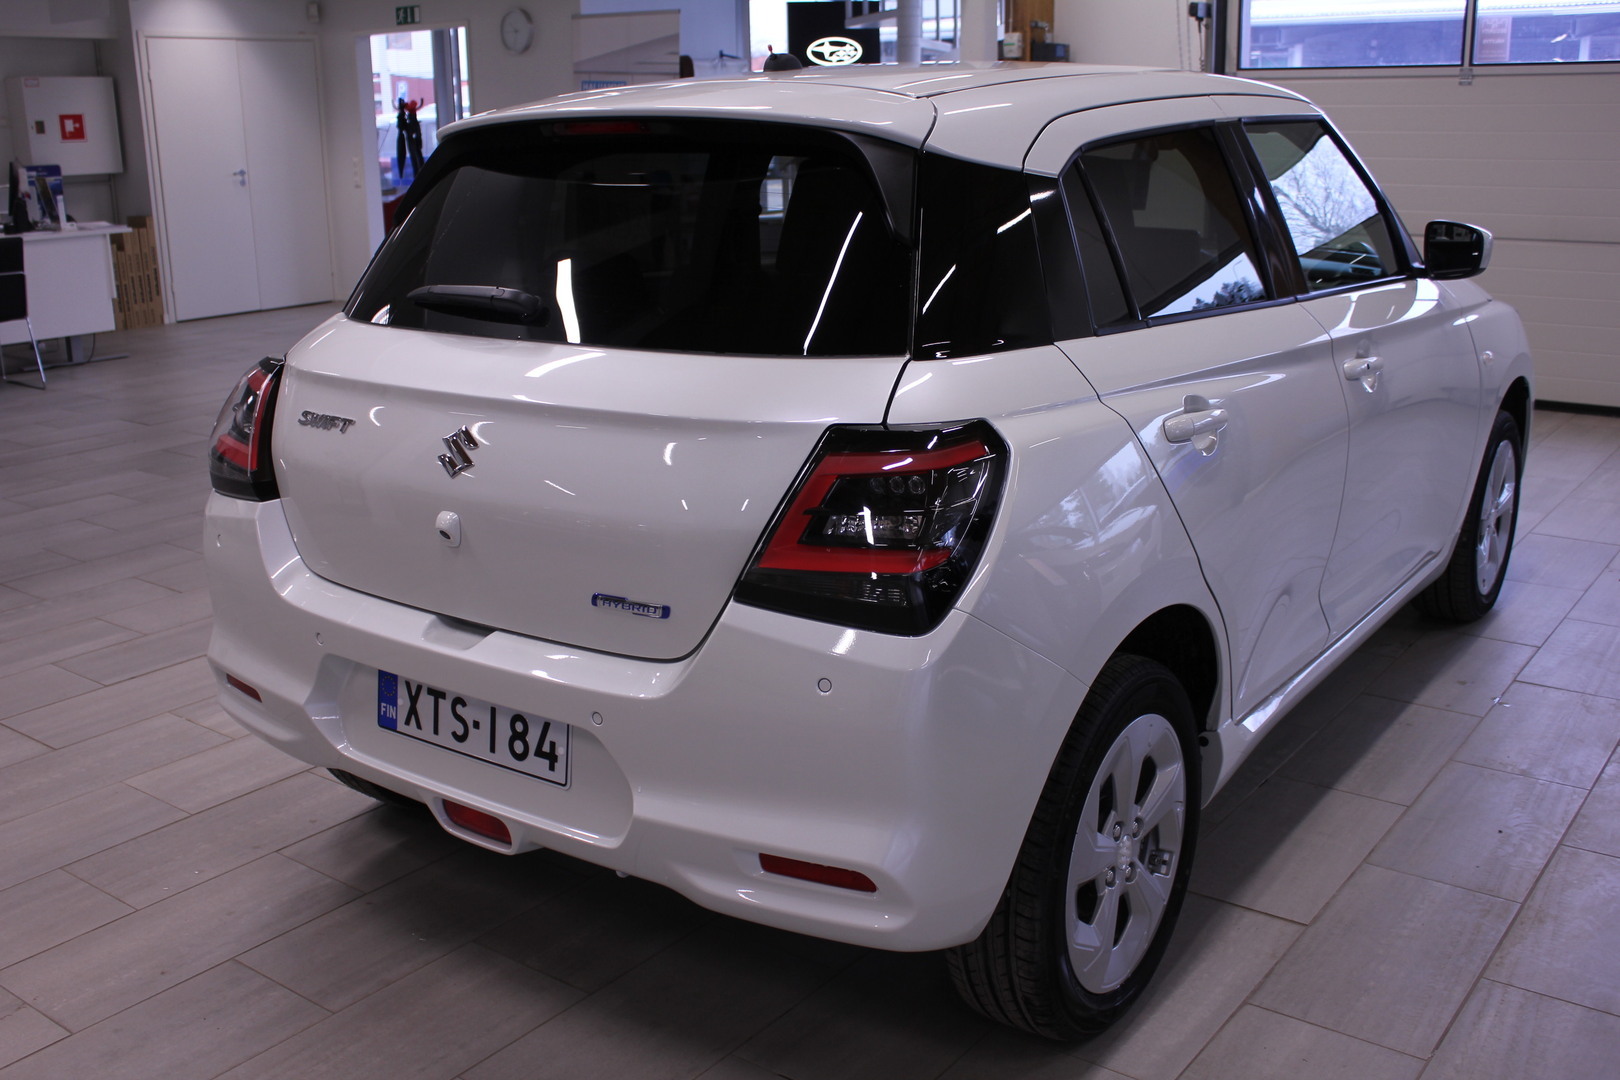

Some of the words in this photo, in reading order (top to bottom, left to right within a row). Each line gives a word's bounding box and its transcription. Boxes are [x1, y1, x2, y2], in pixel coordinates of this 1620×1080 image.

[298, 410, 356, 434] SWIFT
[602, 599, 657, 614] HYBRID
[380, 702, 397, 719] FIN
[404, 680, 559, 772] XTS-184
